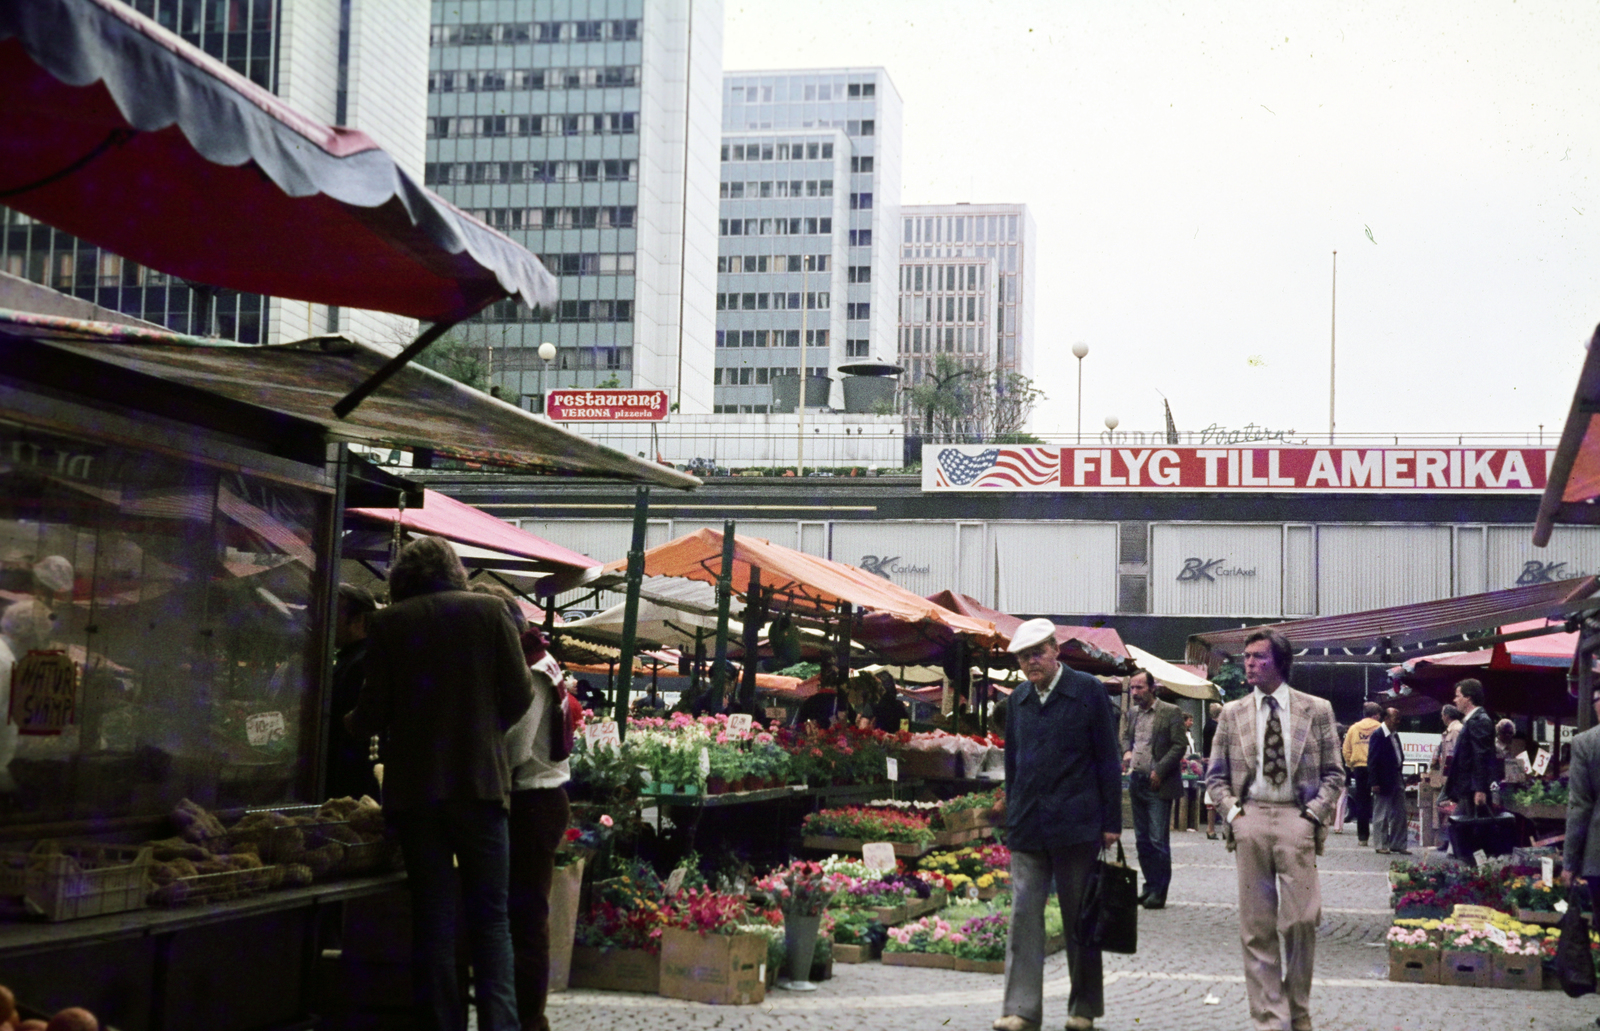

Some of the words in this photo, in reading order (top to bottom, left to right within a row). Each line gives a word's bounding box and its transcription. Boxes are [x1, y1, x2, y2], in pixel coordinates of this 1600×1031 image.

[554, 392, 661, 410] restaurang
[561, 408, 611, 418] VERONA
[615, 409, 653, 419] pizzeria
[1074, 449, 1180, 486] FLYG
[1196, 449, 1295, 487] TILL
[1305, 450, 1533, 488] AMERIKA
[890, 563, 931, 574] CarlAxel
[1176, 557, 1226, 582] BK
[1215, 566, 1257, 577] CarlAxel
